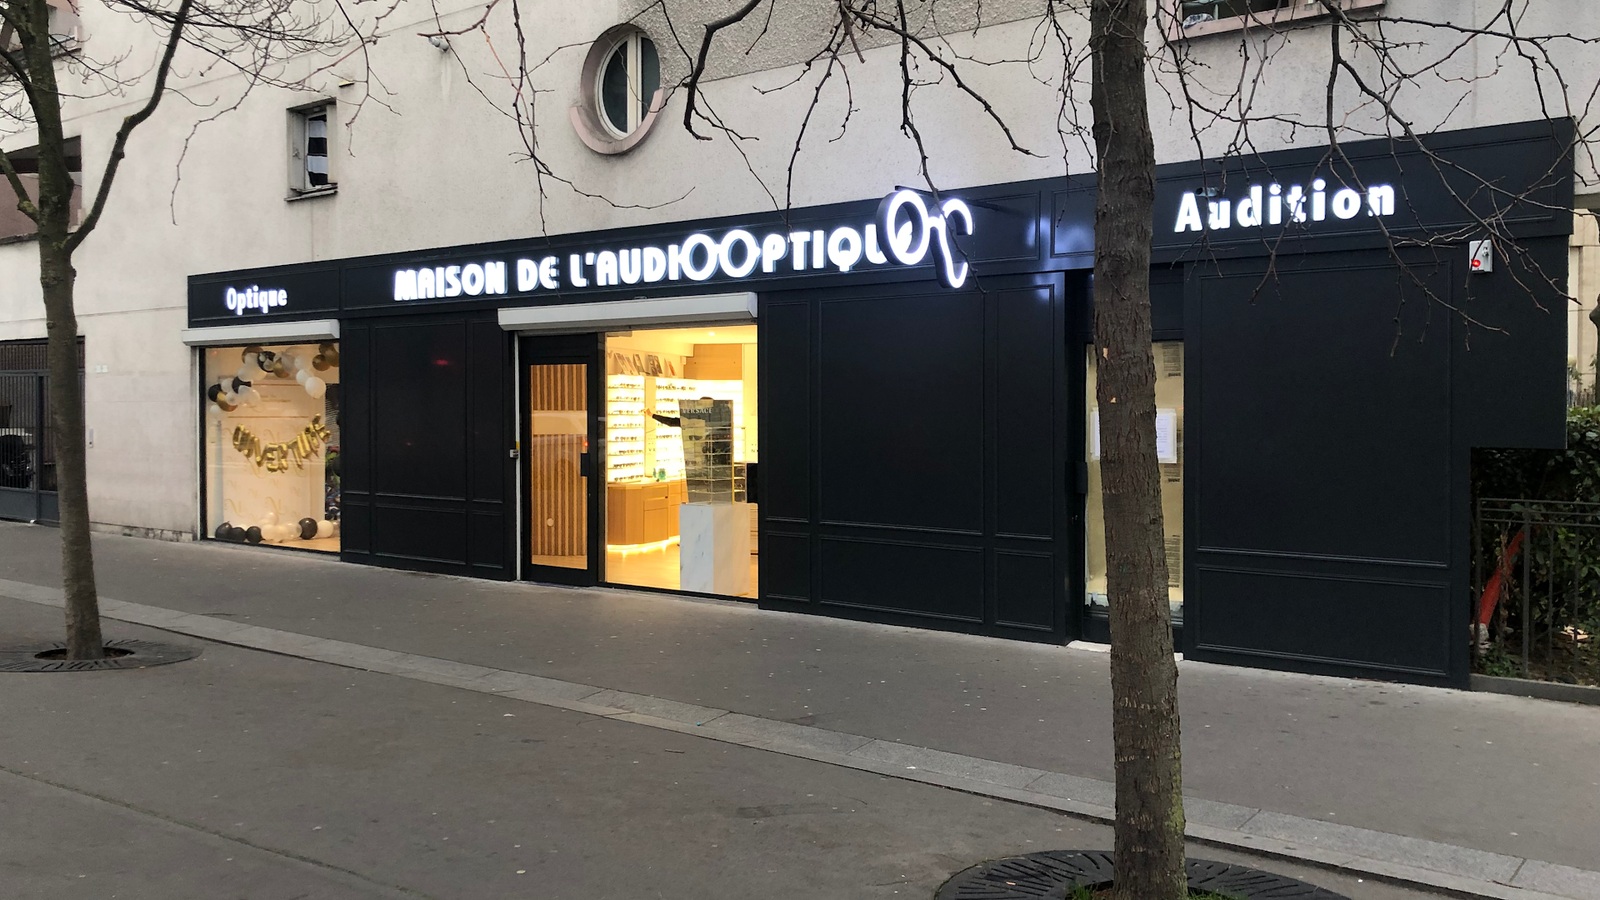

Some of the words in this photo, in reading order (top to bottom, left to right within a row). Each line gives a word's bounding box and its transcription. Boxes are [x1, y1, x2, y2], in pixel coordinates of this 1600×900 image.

[1174, 178, 1395, 233] Audition
[226, 284, 288, 316] Optique
[393, 261, 508, 301] MAISON
[516, 256, 560, 292] DE
